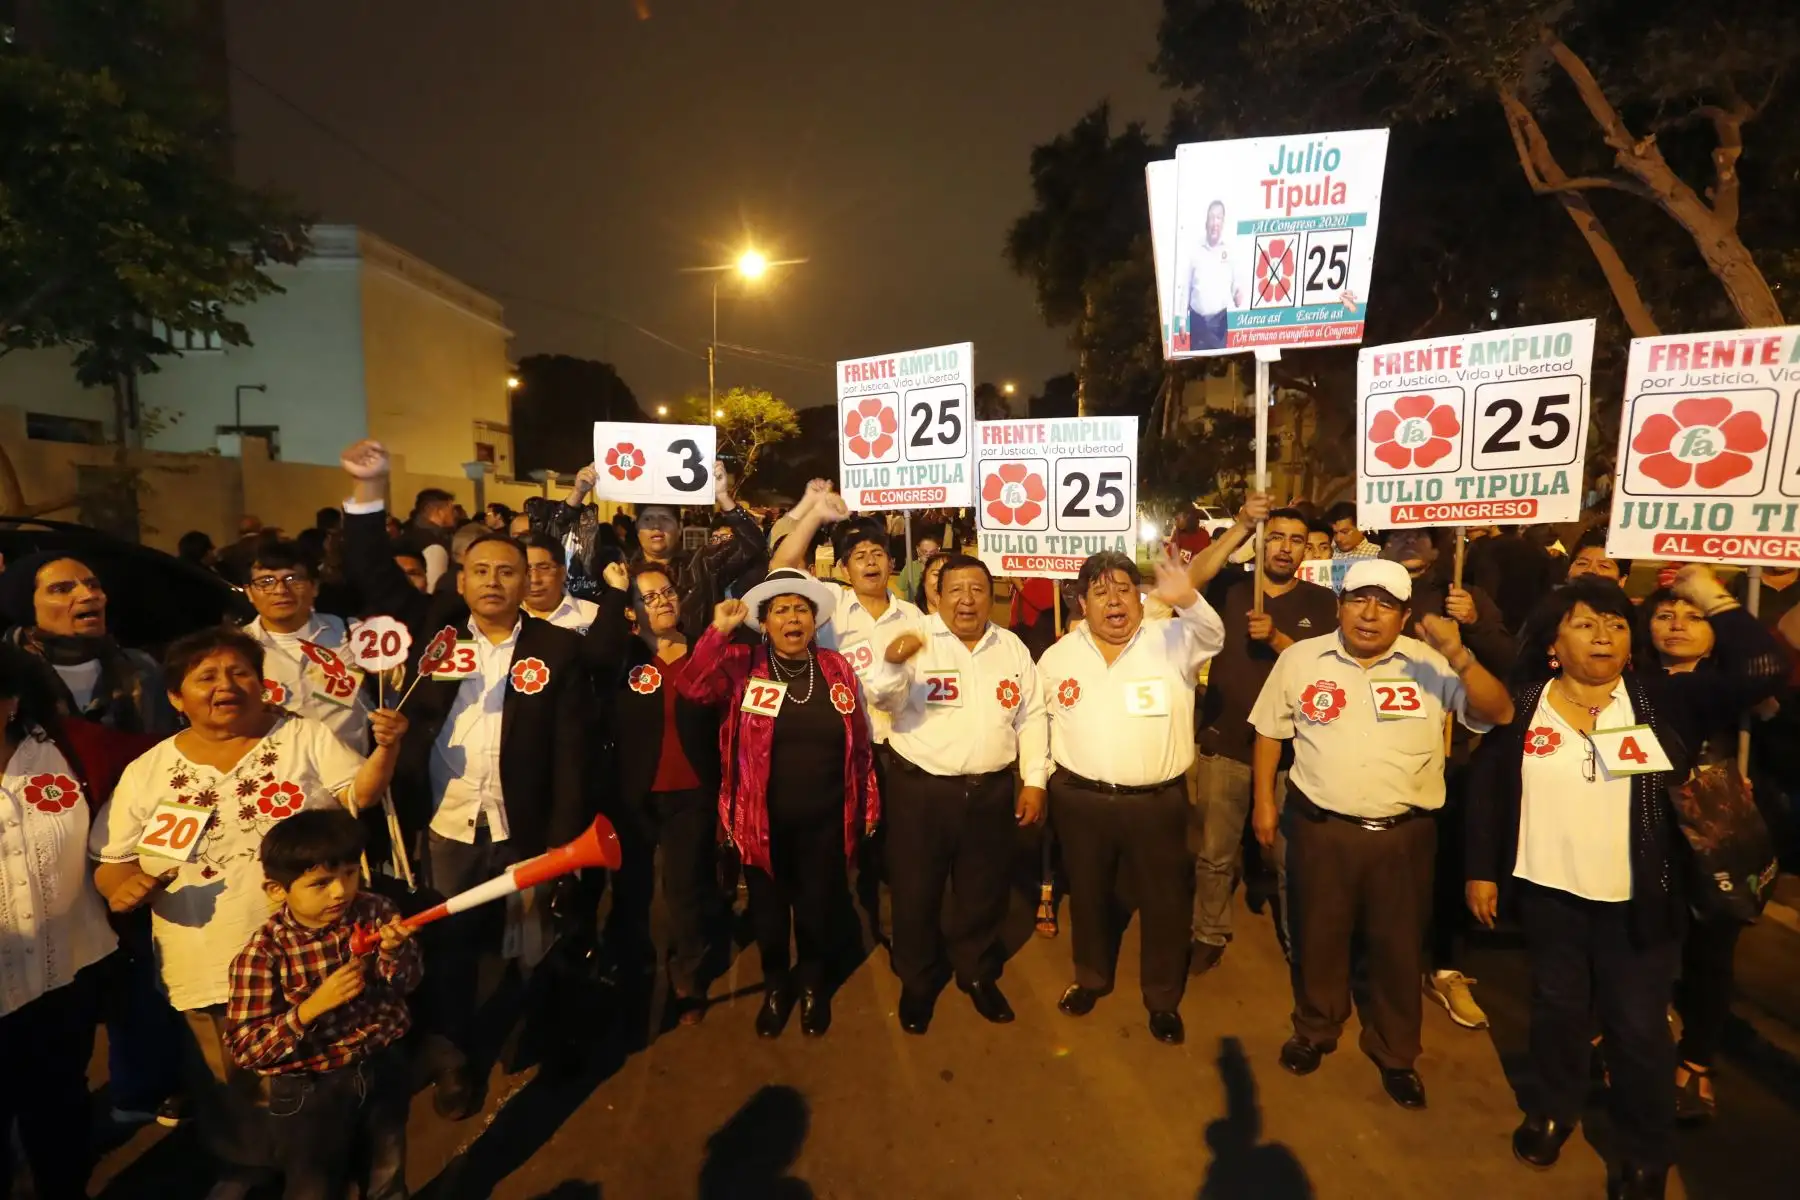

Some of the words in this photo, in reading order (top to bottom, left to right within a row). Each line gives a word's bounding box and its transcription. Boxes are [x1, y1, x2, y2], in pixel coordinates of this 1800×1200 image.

[1268, 141, 1341, 176] Julio
[1260, 175, 1347, 216] Tipula
[1269, 219, 1316, 233] Congreso
[1319, 214, 1349, 228] 2020!
[1305, 244, 1349, 292] 25
[1237, 313, 1265, 326] Marca
[1296, 309, 1329, 321] Escribe
[1249, 327, 1277, 341] hermano
[1315, 324, 1323, 337] al
[1373, 345, 1463, 376] FRENTE
[1468, 332, 1573, 367] AMPLIO
[1648, 335, 1782, 372] FRENTE
[844, 359, 897, 384] FRENTE
[899, 350, 959, 377] AMPLIO
[1369, 380, 1393, 392] por
[1396, 374, 1451, 387] Justicia,
[1456, 368, 1490, 381] Vida
[1494, 368, 1503, 379] y
[1508, 359, 1573, 376] Libertad
[843, 384, 859, 395] por
[859, 382, 890, 393] Justicia,
[893, 377, 914, 389] Vida
[922, 372, 960, 384] Libertad
[1641, 376, 1674, 391] por
[1680, 371, 1759, 387] Justicia,
[910, 398, 962, 447] 25
[982, 423, 1046, 445] FRENTE
[1051, 420, 1122, 443] AMPLIO
[1481, 393, 1571, 454] 25
[980, 448, 997, 456] por
[999, 446, 1038, 456] Justicia,
[1041, 444, 1066, 454] Vida
[1068, 446, 1076, 455] y
[1077, 443, 1124, 454] Libertad
[666, 438, 709, 492] 3
[844, 467, 890, 489] JULIO
[896, 462, 964, 486] TIPULA
[863, 491, 877, 504] AL
[879, 488, 944, 503] CONGRESO
[1061, 471, 1125, 518] 25
[1365, 478, 1443, 504] JULIO
[1454, 470, 1570, 499] TIPULA
[1395, 506, 1419, 521] AL
[1423, 501, 1532, 520] CONGRESO
[1619, 501, 1734, 531] JULIO
[1752, 503, 1800, 532] TI
[982, 534, 1038, 554] JULIO
[1045, 535, 1127, 555] TIPULA
[1661, 536, 1695, 553] AL
[1702, 537, 1800, 557] CONGR
[1006, 558, 1024, 569] AL
[1026, 558, 1084, 571] CONGRE
[359, 629, 401, 660] 20
[749, 685, 778, 710] 12
[926, 677, 959, 701] 25
[1135, 686, 1155, 710] 5
[1376, 686, 1421, 711] 23
[1617, 736, 1649, 764] 4
[142, 812, 199, 850] 20
